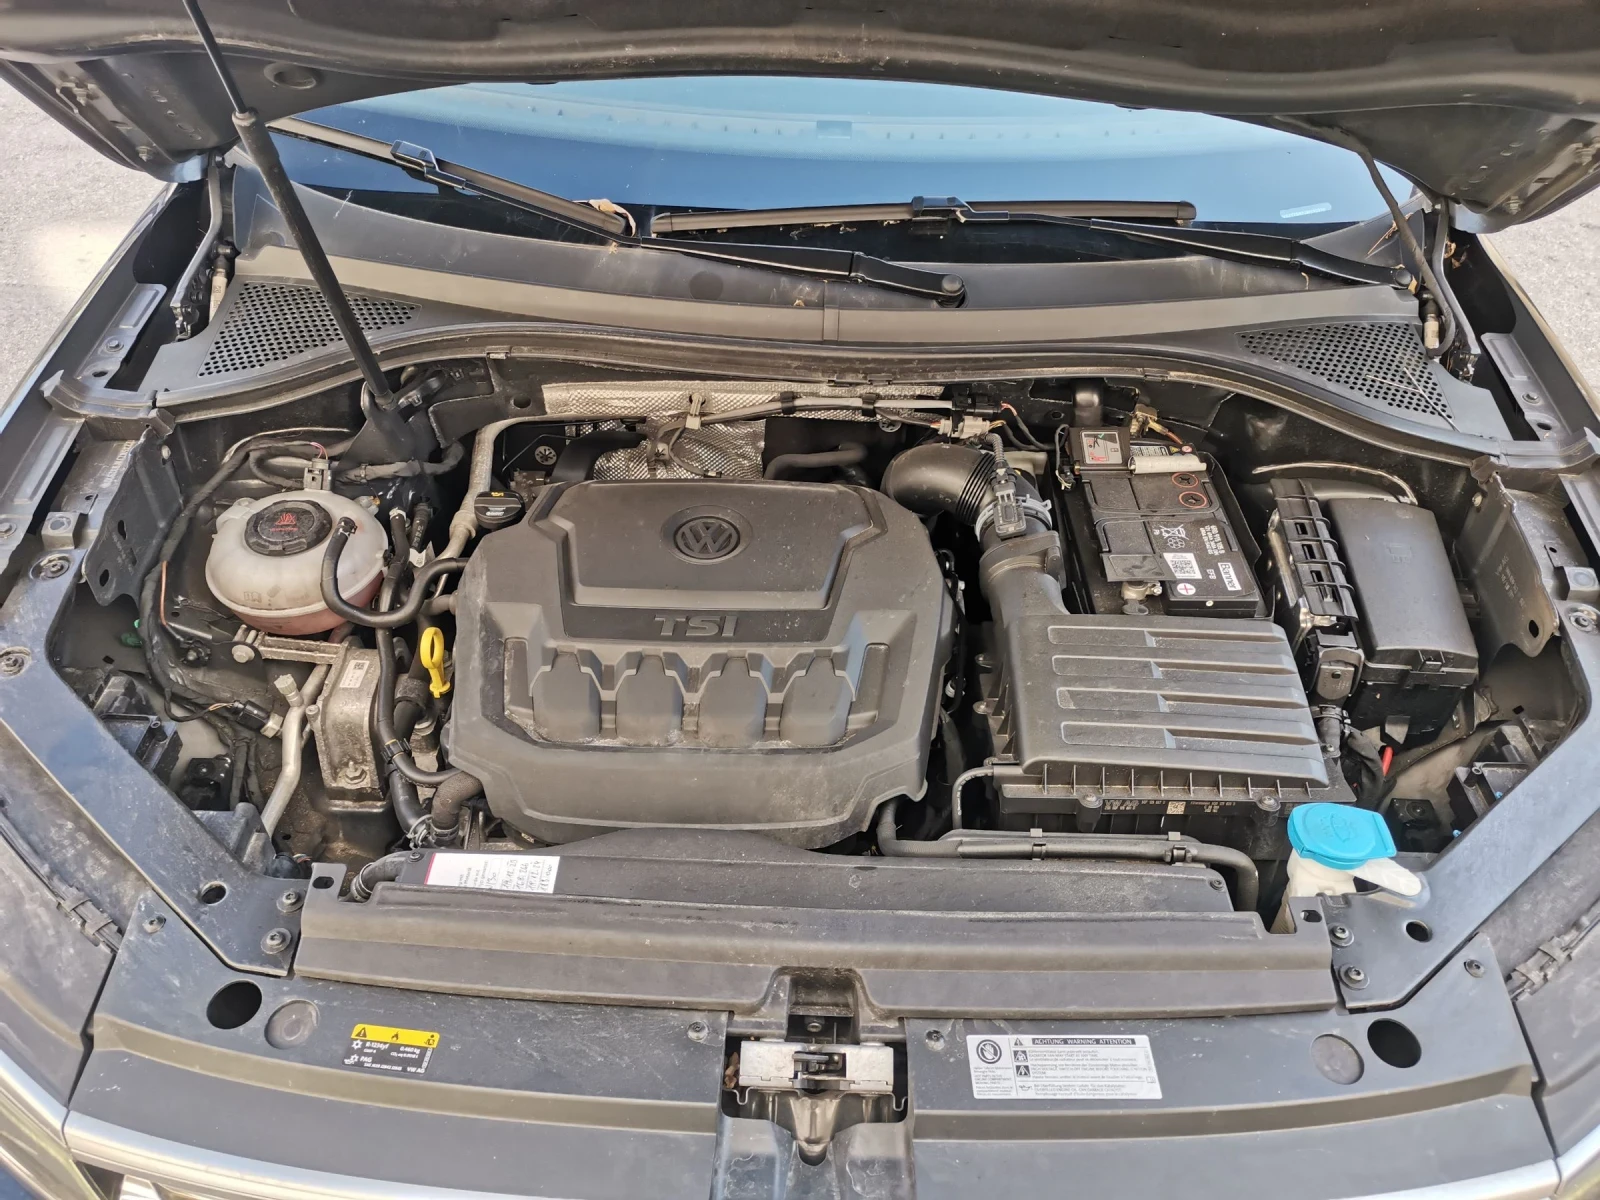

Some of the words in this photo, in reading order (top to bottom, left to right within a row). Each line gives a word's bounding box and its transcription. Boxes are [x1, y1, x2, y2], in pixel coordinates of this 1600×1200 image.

[1206, 569, 1217, 580] EFB
[1220, 563, 1237, 589] Banner
[654, 614, 738, 637] TSI
[365, 1041, 390, 1050] R-1234yf
